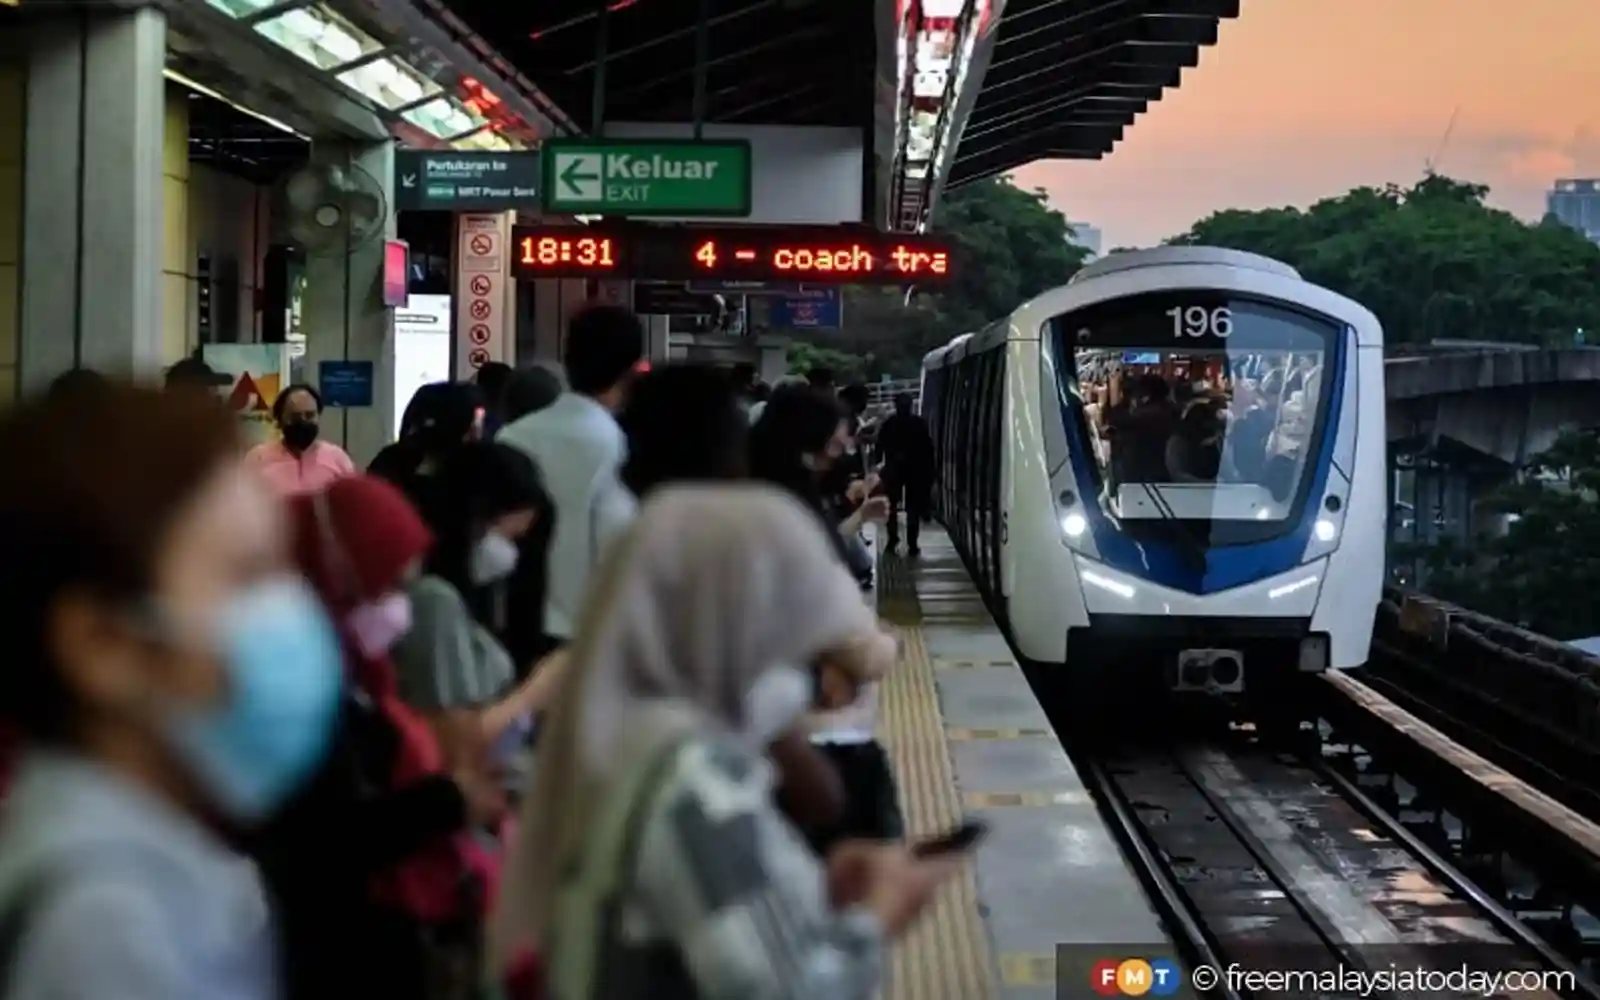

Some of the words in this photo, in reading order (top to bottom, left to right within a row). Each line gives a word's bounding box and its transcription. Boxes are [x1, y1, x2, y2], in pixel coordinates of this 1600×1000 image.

[606, 154, 719, 180] Keluar
[606, 185, 650, 201] EXIT
[520, 237, 614, 266] 18:31
[696, 241, 717, 267] 4
[774, 244, 872, 271] coach
[892, 245, 947, 273] tra
[1165, 306, 1233, 338] 196
